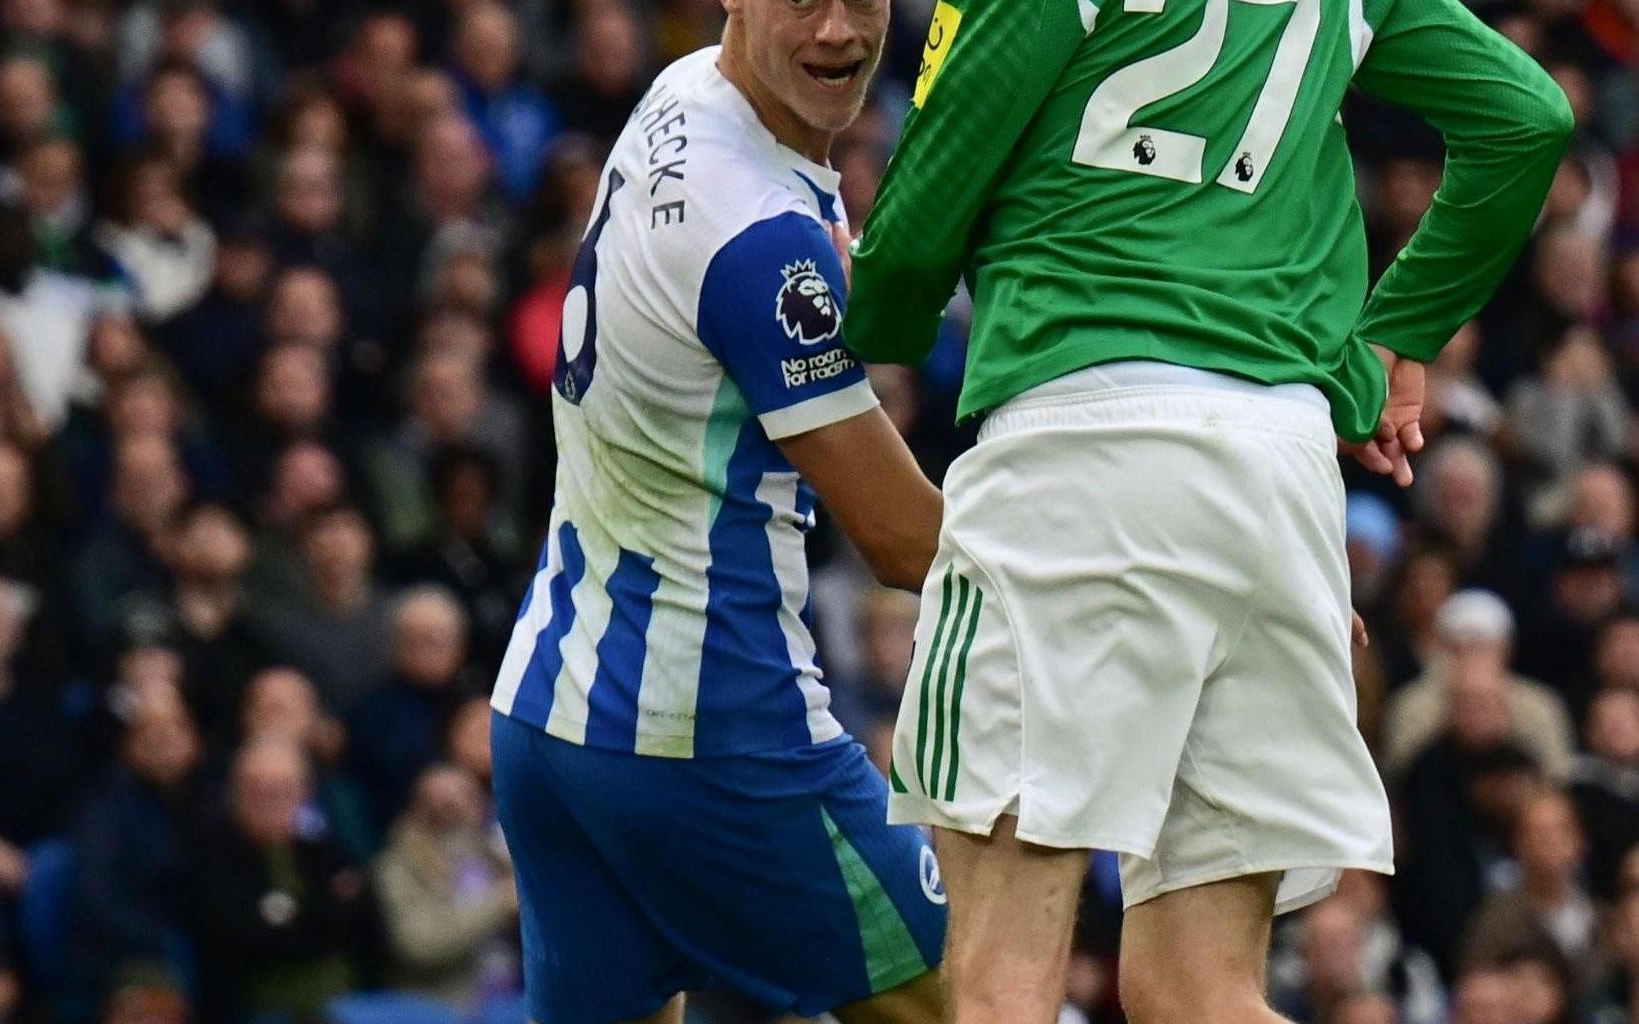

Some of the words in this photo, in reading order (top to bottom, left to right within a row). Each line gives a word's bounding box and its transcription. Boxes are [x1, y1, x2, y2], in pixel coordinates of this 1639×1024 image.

[640, 93, 688, 230] HECKE
[780, 358, 807, 374] No
[783, 372, 808, 389] for
